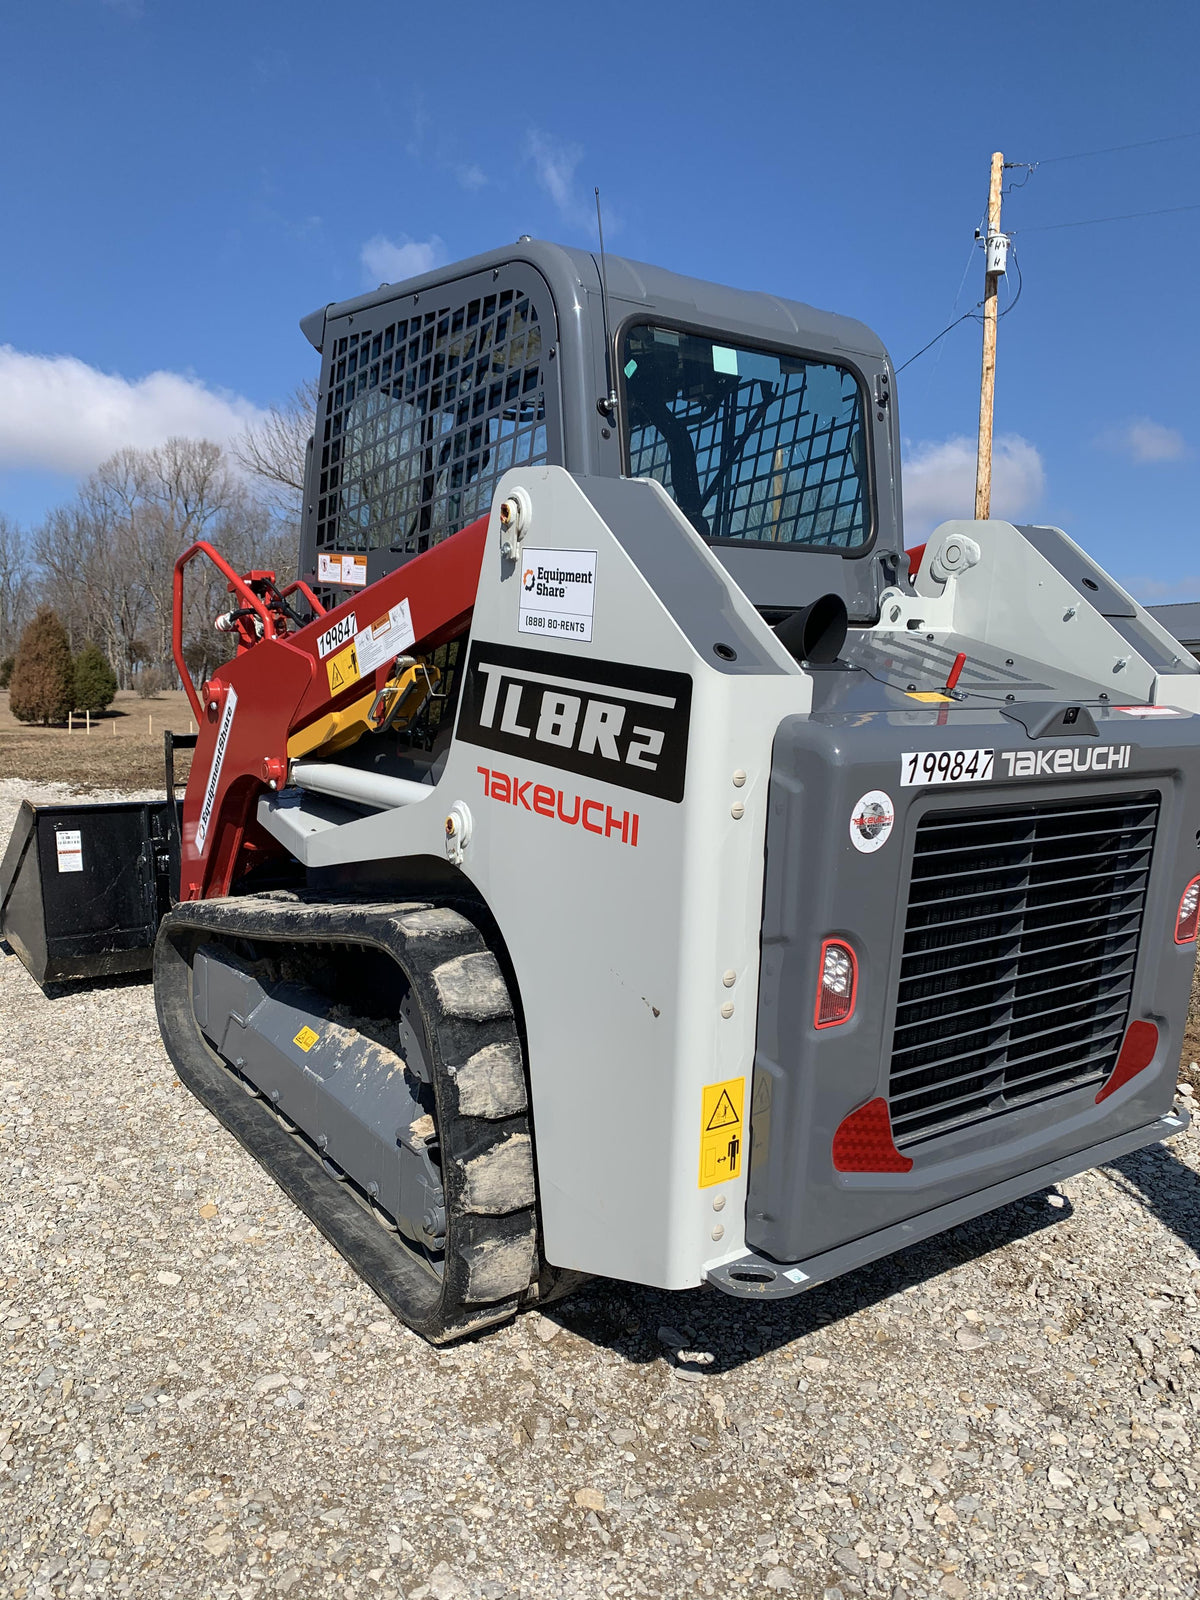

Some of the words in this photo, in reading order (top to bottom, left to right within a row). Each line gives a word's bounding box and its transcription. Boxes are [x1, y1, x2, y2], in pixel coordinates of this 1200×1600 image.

[536, 566, 593, 585] Equipment
[536, 582, 566, 598] Share
[319, 612, 357, 656] 199847
[525, 615, 546, 629] (888)
[547, 618, 585, 633] 80-RENTS
[478, 662, 676, 772] TL8R2
[201, 705, 233, 826] EquipmentShare
[908, 749, 994, 784] 199847
[1001, 745, 1131, 777] TAKEUCHI
[477, 765, 640, 847] TAKEUCHI
